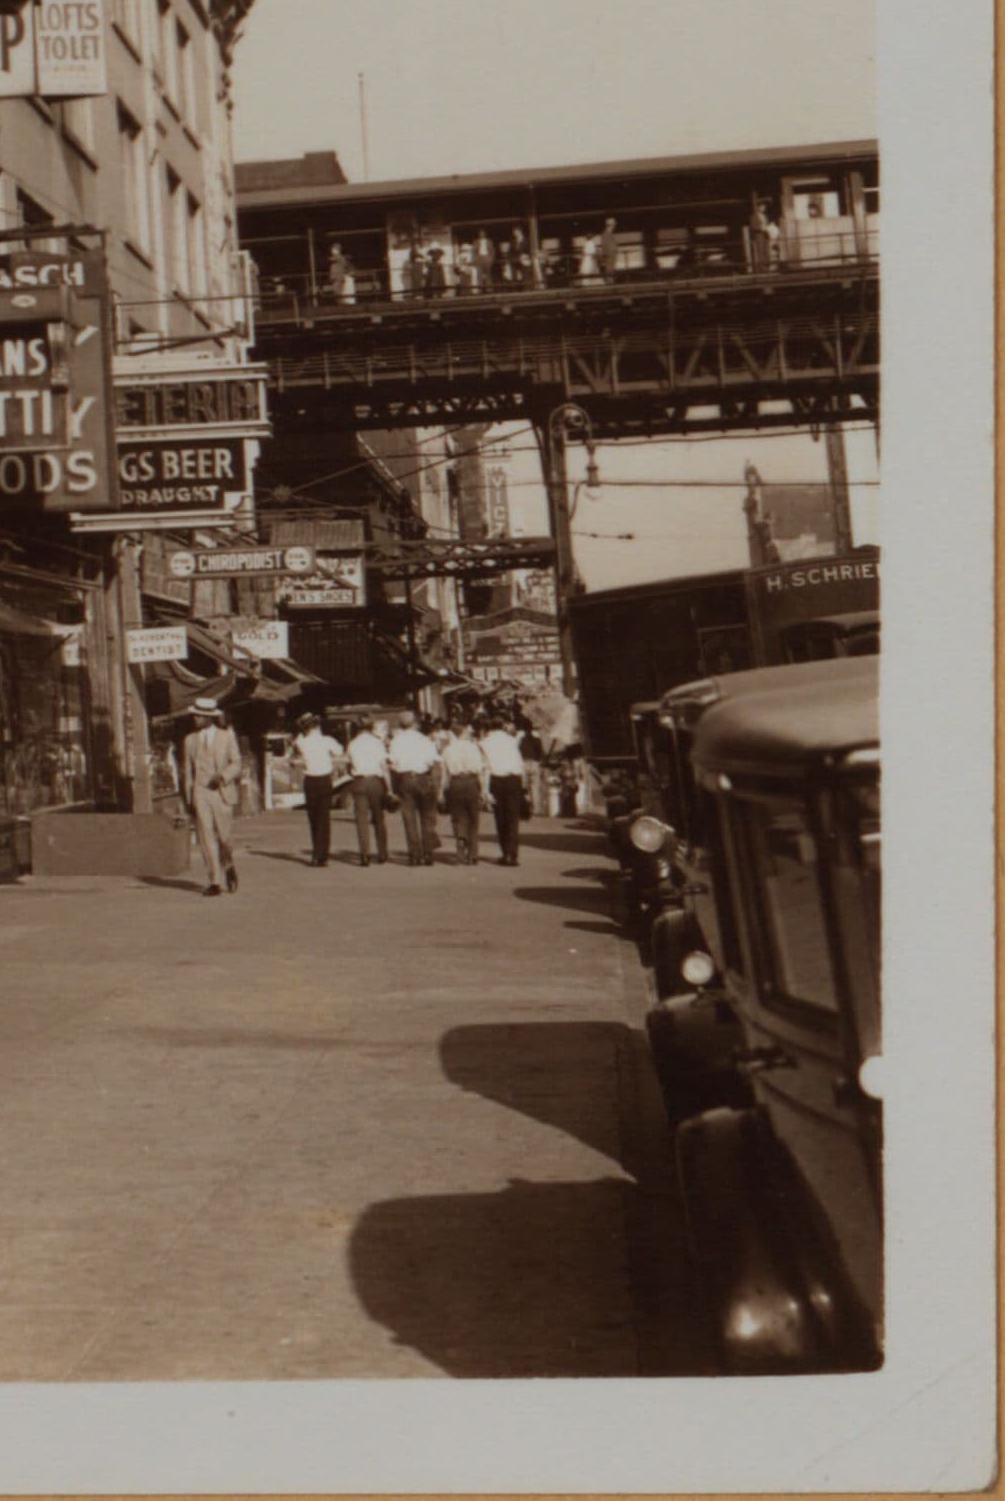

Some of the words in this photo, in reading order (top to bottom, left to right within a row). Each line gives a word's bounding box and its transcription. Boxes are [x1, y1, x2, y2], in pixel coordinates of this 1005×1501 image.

[39, 2, 99, 31] LOFTS
[41, 35, 64, 60] TO
[70, 34, 101, 61] LET
[161, 448, 234, 480] BEER
[121, 485, 220, 505] DRAUGHT
[198, 550, 283, 573] CHIROPODIST
[132, 643, 182, 657] DENTIST
